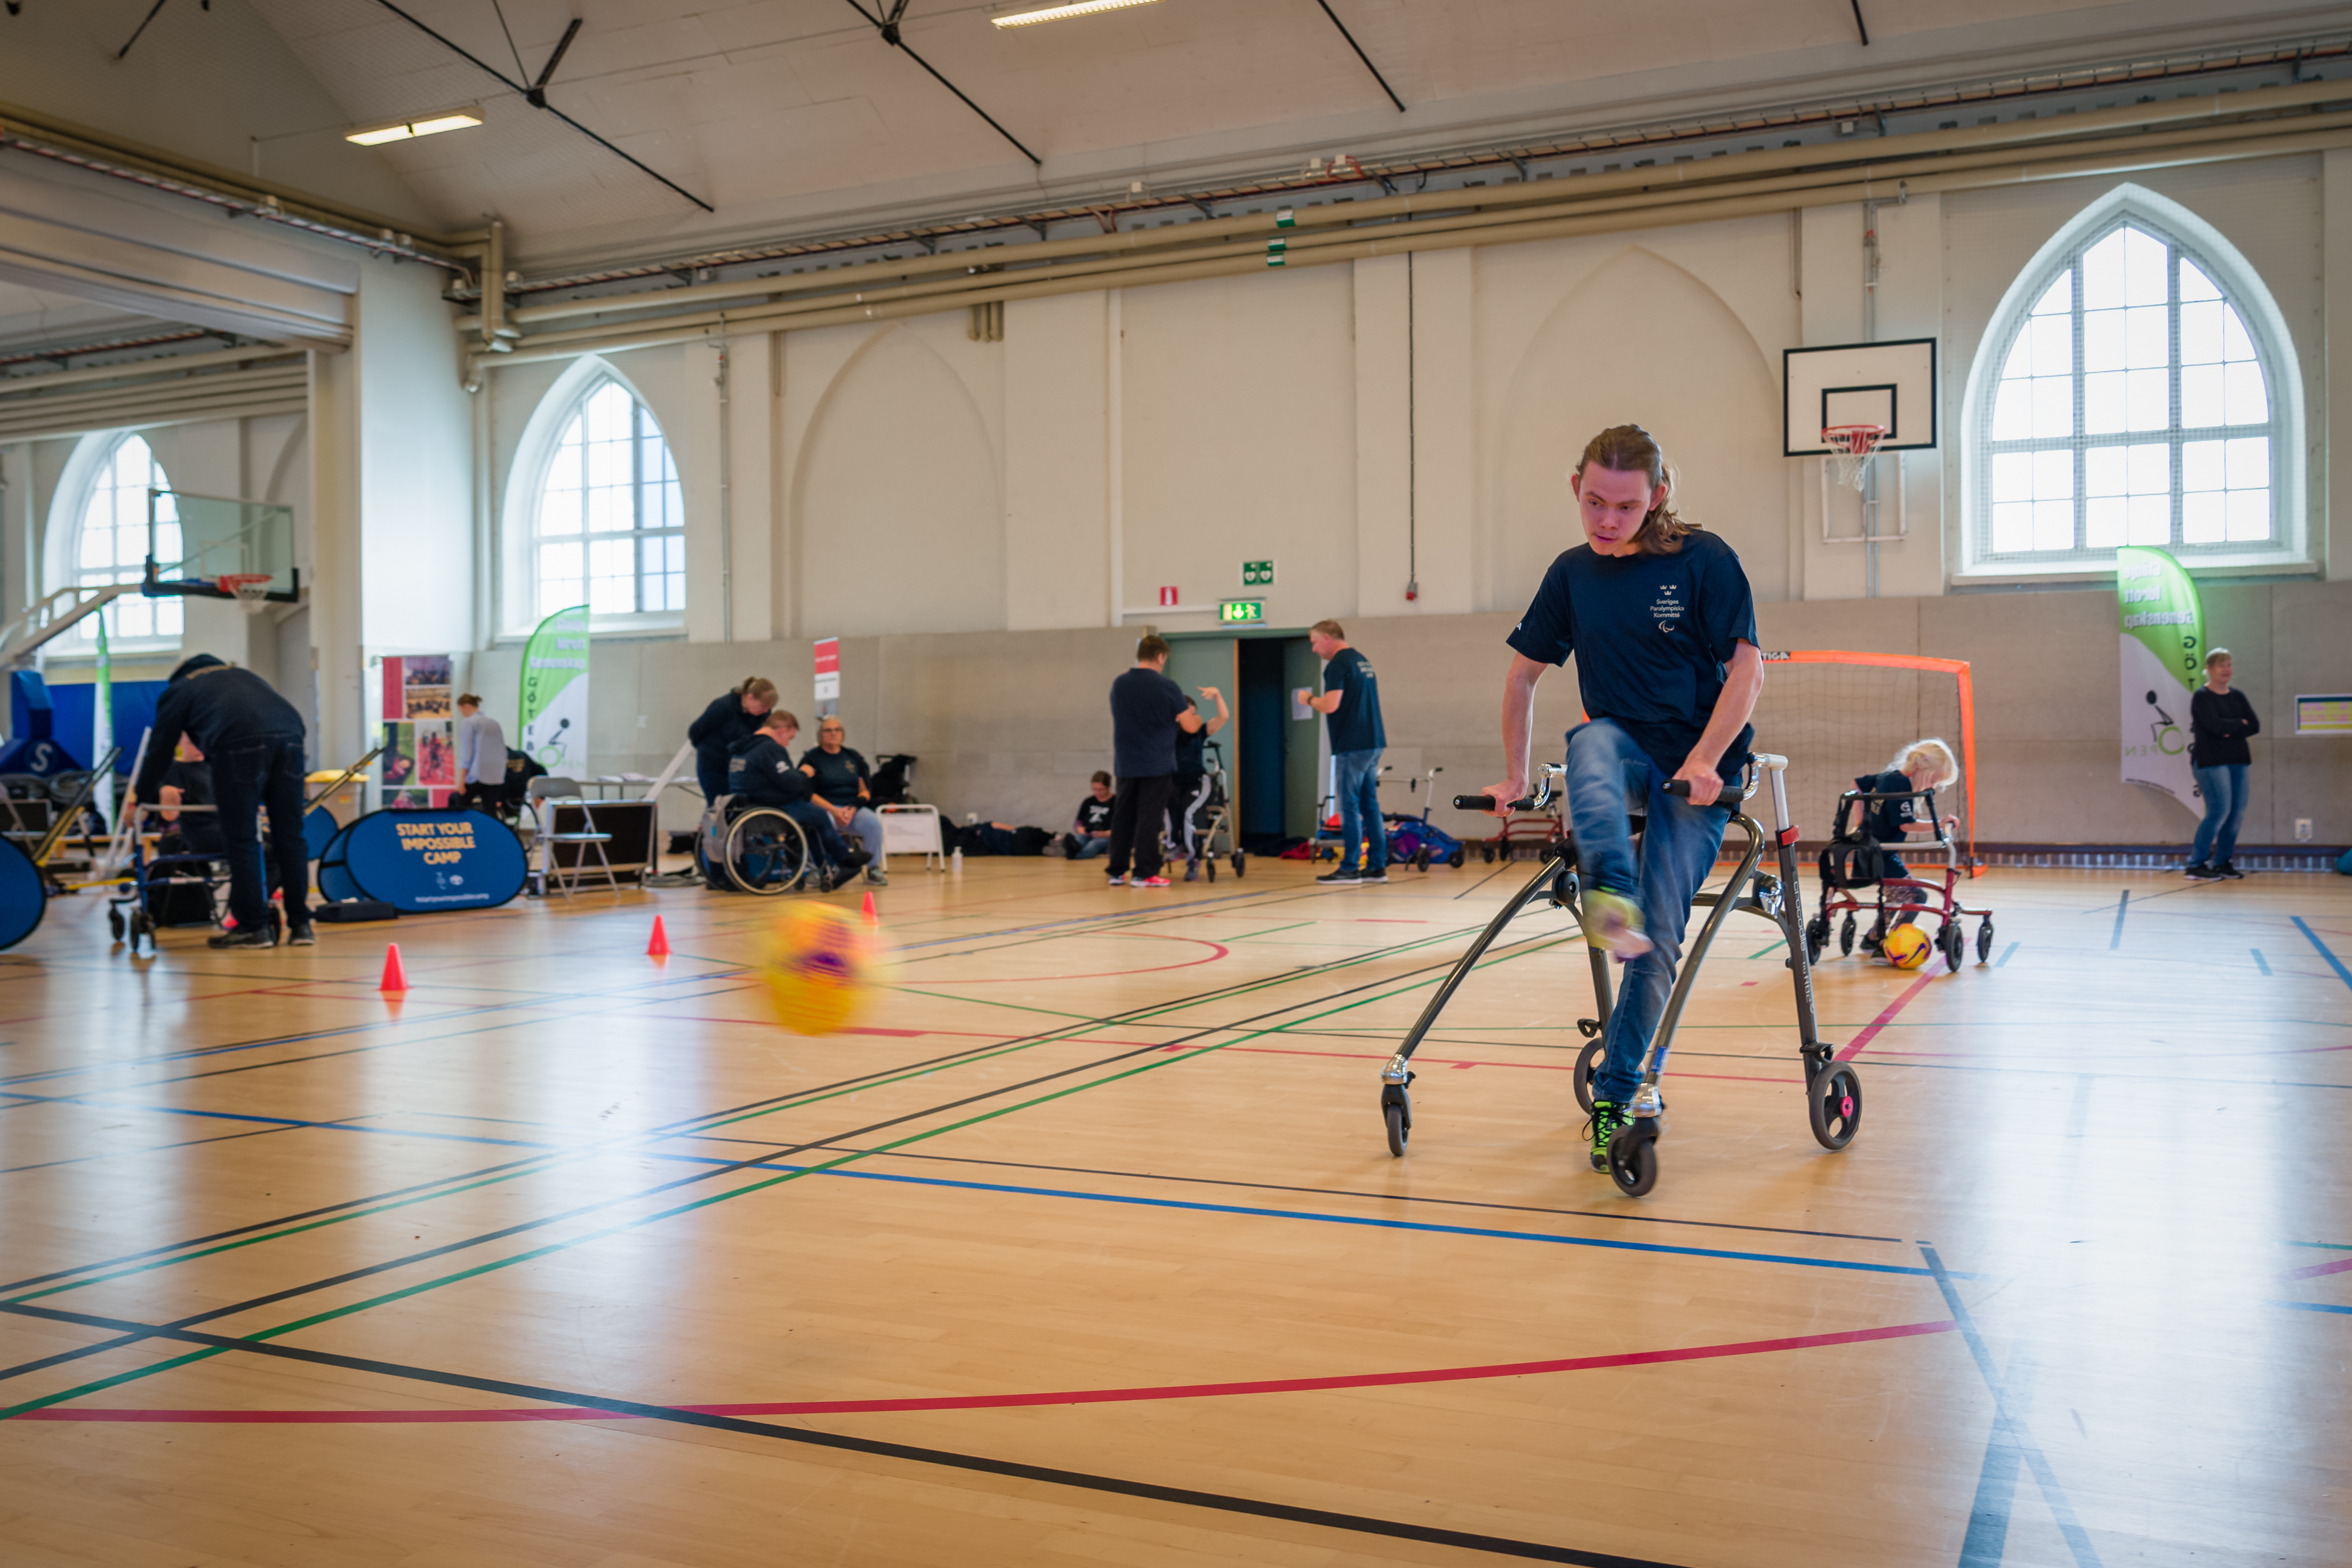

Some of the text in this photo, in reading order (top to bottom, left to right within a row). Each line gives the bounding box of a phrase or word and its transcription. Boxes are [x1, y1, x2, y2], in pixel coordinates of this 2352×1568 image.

[31, 743, 52, 772] S
[396, 822, 473, 836] START YOUR
[401, 836, 476, 850] IMPOSSIBLE
[423, 851, 462, 864] CAMP
